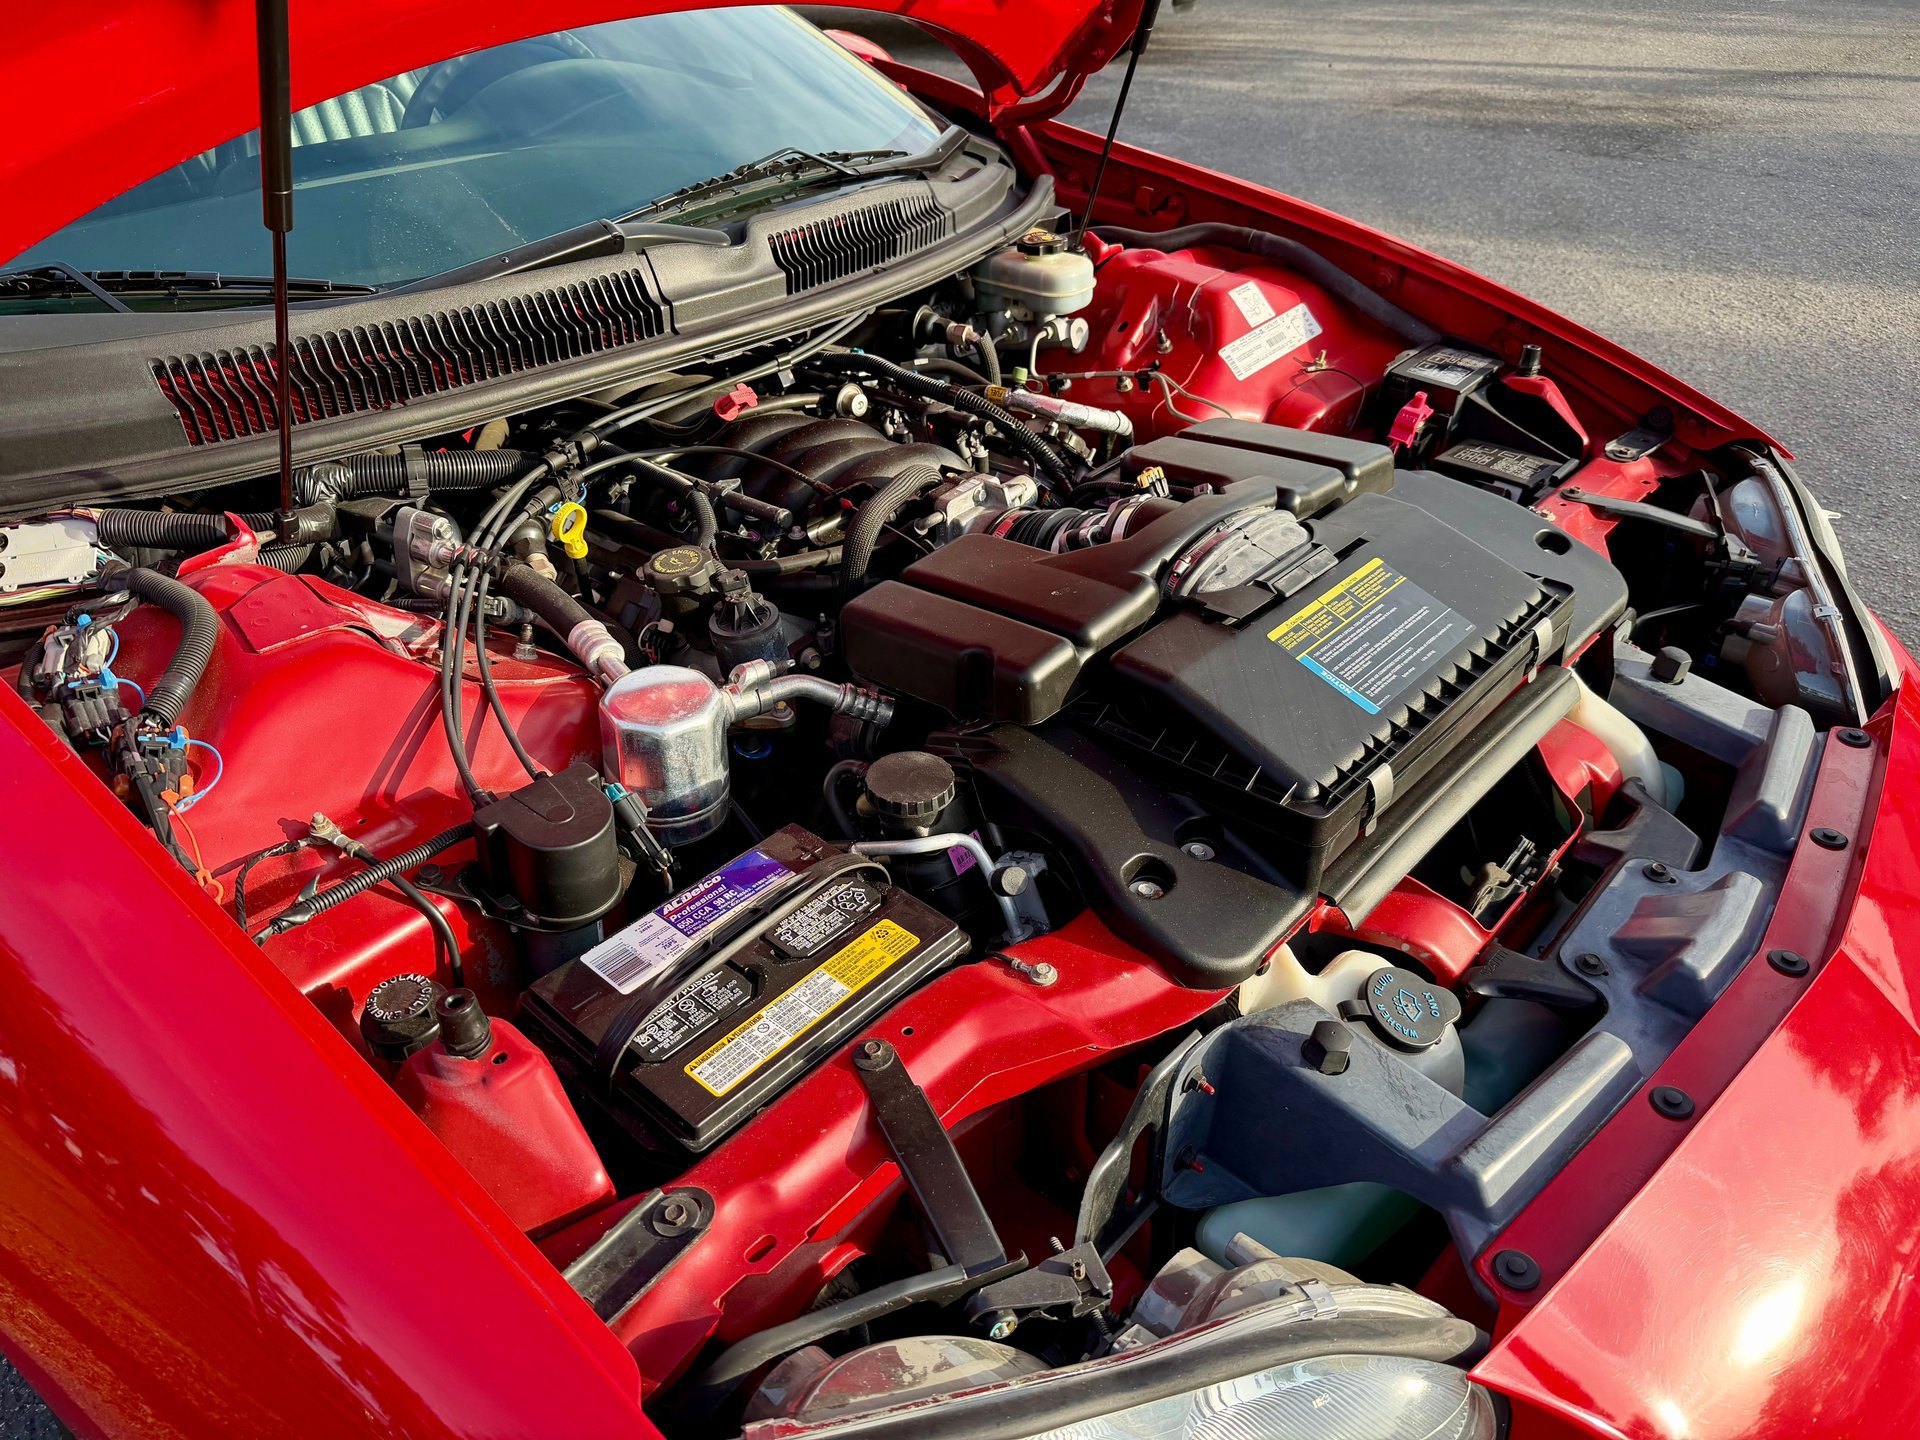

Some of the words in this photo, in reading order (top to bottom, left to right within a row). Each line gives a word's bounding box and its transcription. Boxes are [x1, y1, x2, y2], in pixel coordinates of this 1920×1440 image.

[1320, 670, 1351, 694] NOTICE
[662, 875, 722, 915] ACDelco
[669, 884, 727, 922] Professional
[675, 917, 694, 929] 650
[691, 904, 713, 919] CCA
[711, 896, 726, 906] 90
[722, 889, 738, 899] RC
[372, 973, 431, 994] COOLANT
[1373, 973, 1394, 997] FLUID
[367, 998, 401, 1020] ENGINE
[406, 987, 433, 1014] ONLY
[1422, 992, 1440, 1018] ONLY
[1377, 1003, 1419, 1038] WASHER
